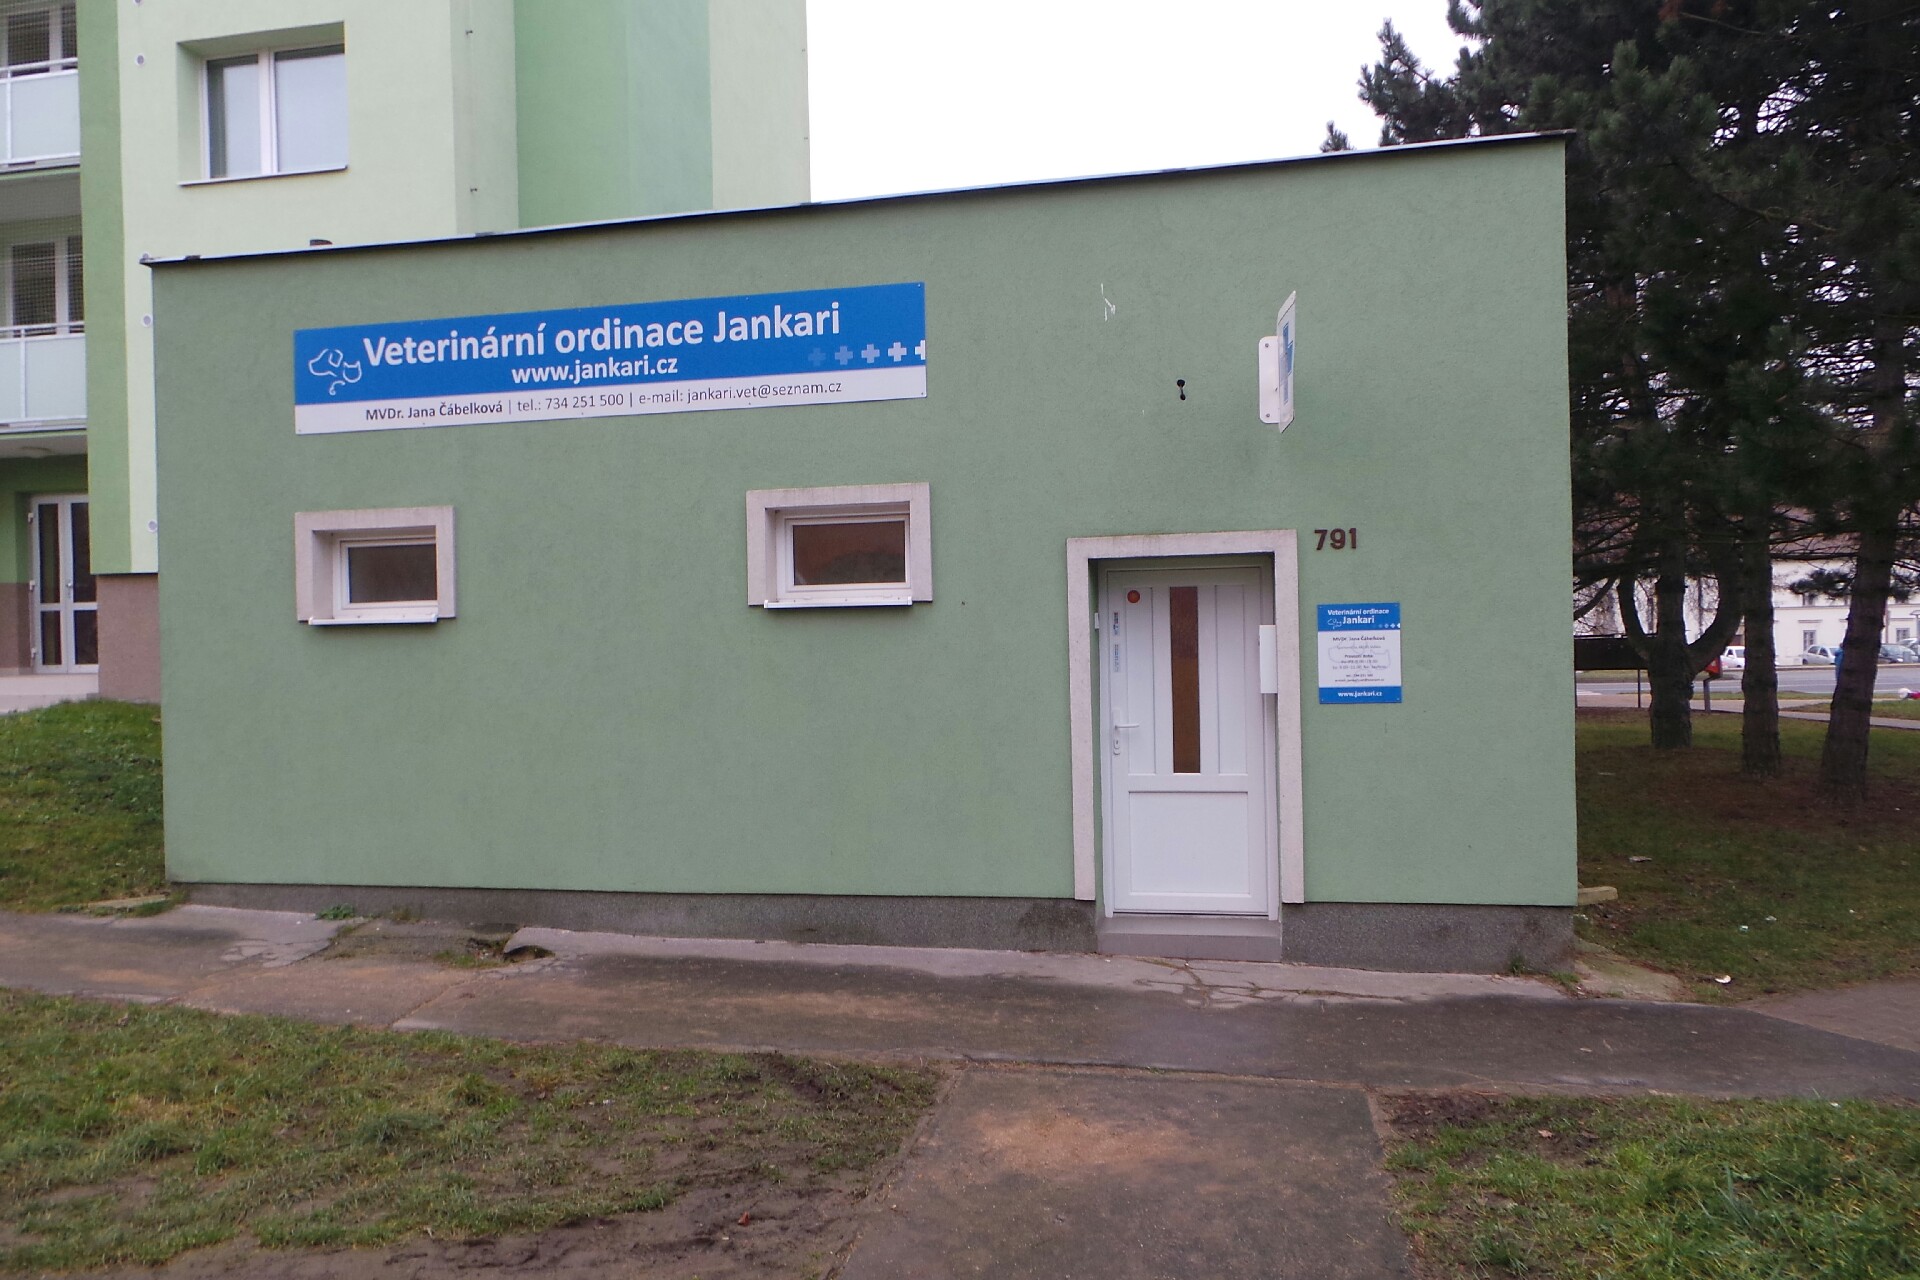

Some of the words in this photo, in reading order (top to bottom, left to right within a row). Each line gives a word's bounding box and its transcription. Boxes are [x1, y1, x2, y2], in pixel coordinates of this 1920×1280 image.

[363, 322, 547, 367] Veterinární
[555, 317, 704, 354] ordinace
[713, 301, 840, 343] Jankari
[511, 354, 678, 385] www.jankari.cz
[366, 407, 404, 421] MVDr.
[407, 406, 436, 419] Jana
[439, 400, 503, 416] Čábelková
[517, 399, 541, 412] tel.:
[546, 397, 568, 410] 734
[572, 395, 596, 408] 251
[600, 393, 624, 407] 500
[639, 389, 683, 404] e-mail:
[687, 380, 842, 404] jankari.vet@seznam.cz
[1314, 527, 1357, 551] 791
[1327, 608, 1362, 616] Veterinární
[1342, 615, 1375, 625] Jankari
[1337, 690, 1383, 698] www.jankari.cz
